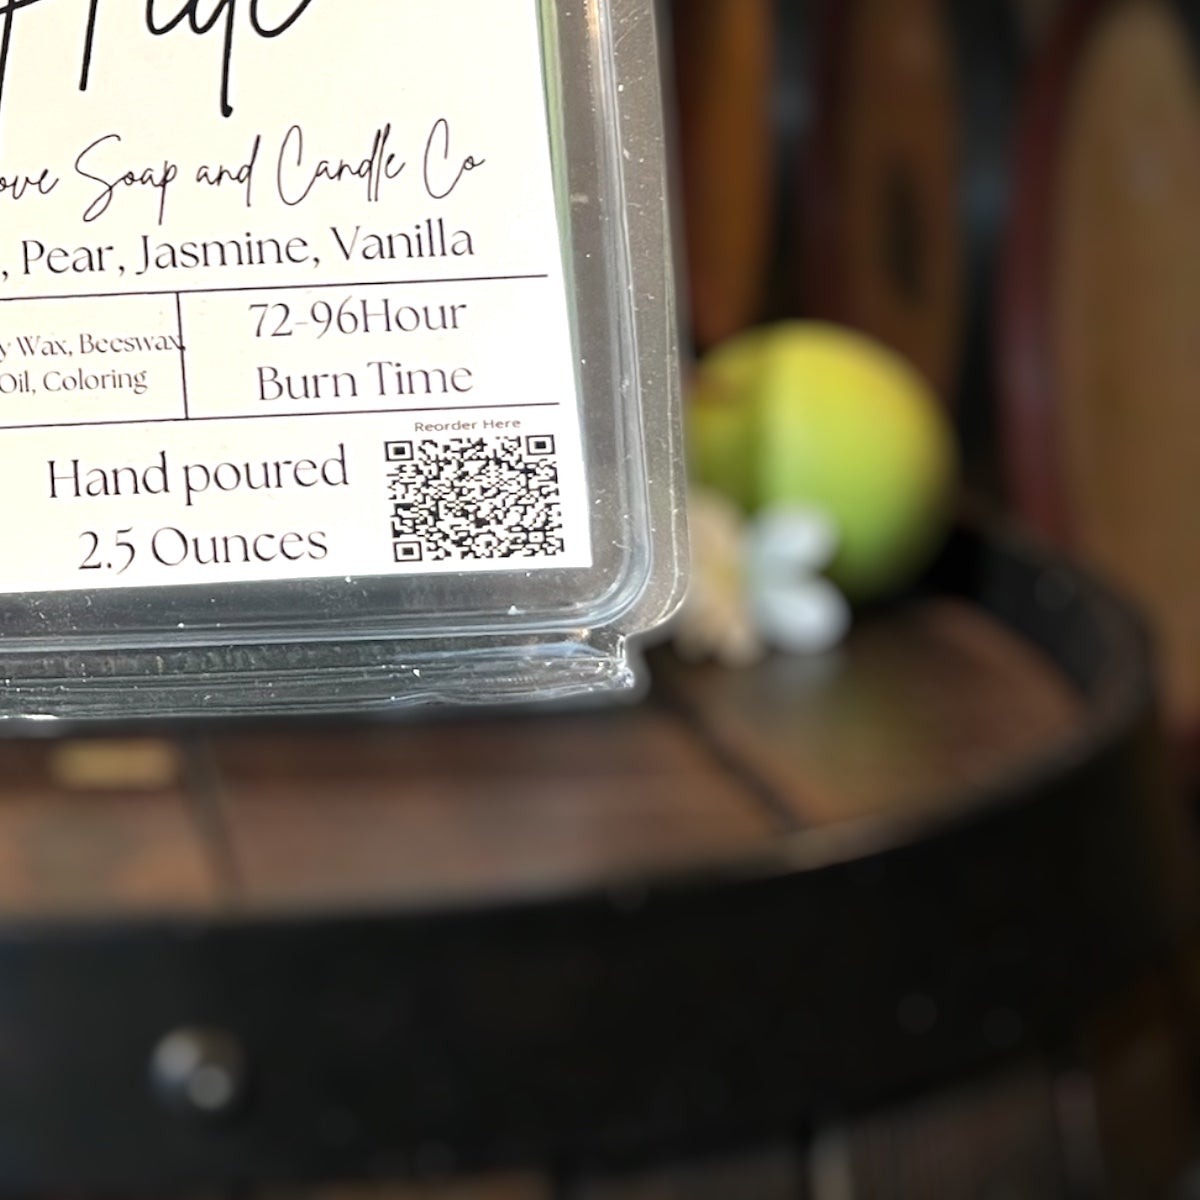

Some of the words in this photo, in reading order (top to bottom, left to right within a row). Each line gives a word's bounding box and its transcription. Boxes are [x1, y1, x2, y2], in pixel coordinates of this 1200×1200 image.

[74, 134, 178, 225] Soap
[196, 134, 261, 208] and
[277, 123, 406, 206] Candle
[423, 118, 485, 199] Co
[21, 240, 125, 275] Pear,
[135, 233, 320, 275] Jasmine,
[329, 218, 474, 260] Vanilla
[249, 297, 466, 339] 72-96Hour
[16, 335, 73, 357] Wax,
[43, 367, 148, 394] Coloring
[257, 367, 359, 400] Burn
[367, 362, 474, 396] Time
[414, 420, 477, 432] Reorder
[482, 418, 521, 429] Here
[48, 450, 170, 498] Hand
[182, 442, 349, 507] poured
[79, 527, 136, 573] 2.5
[150, 527, 328, 566] Ounces
